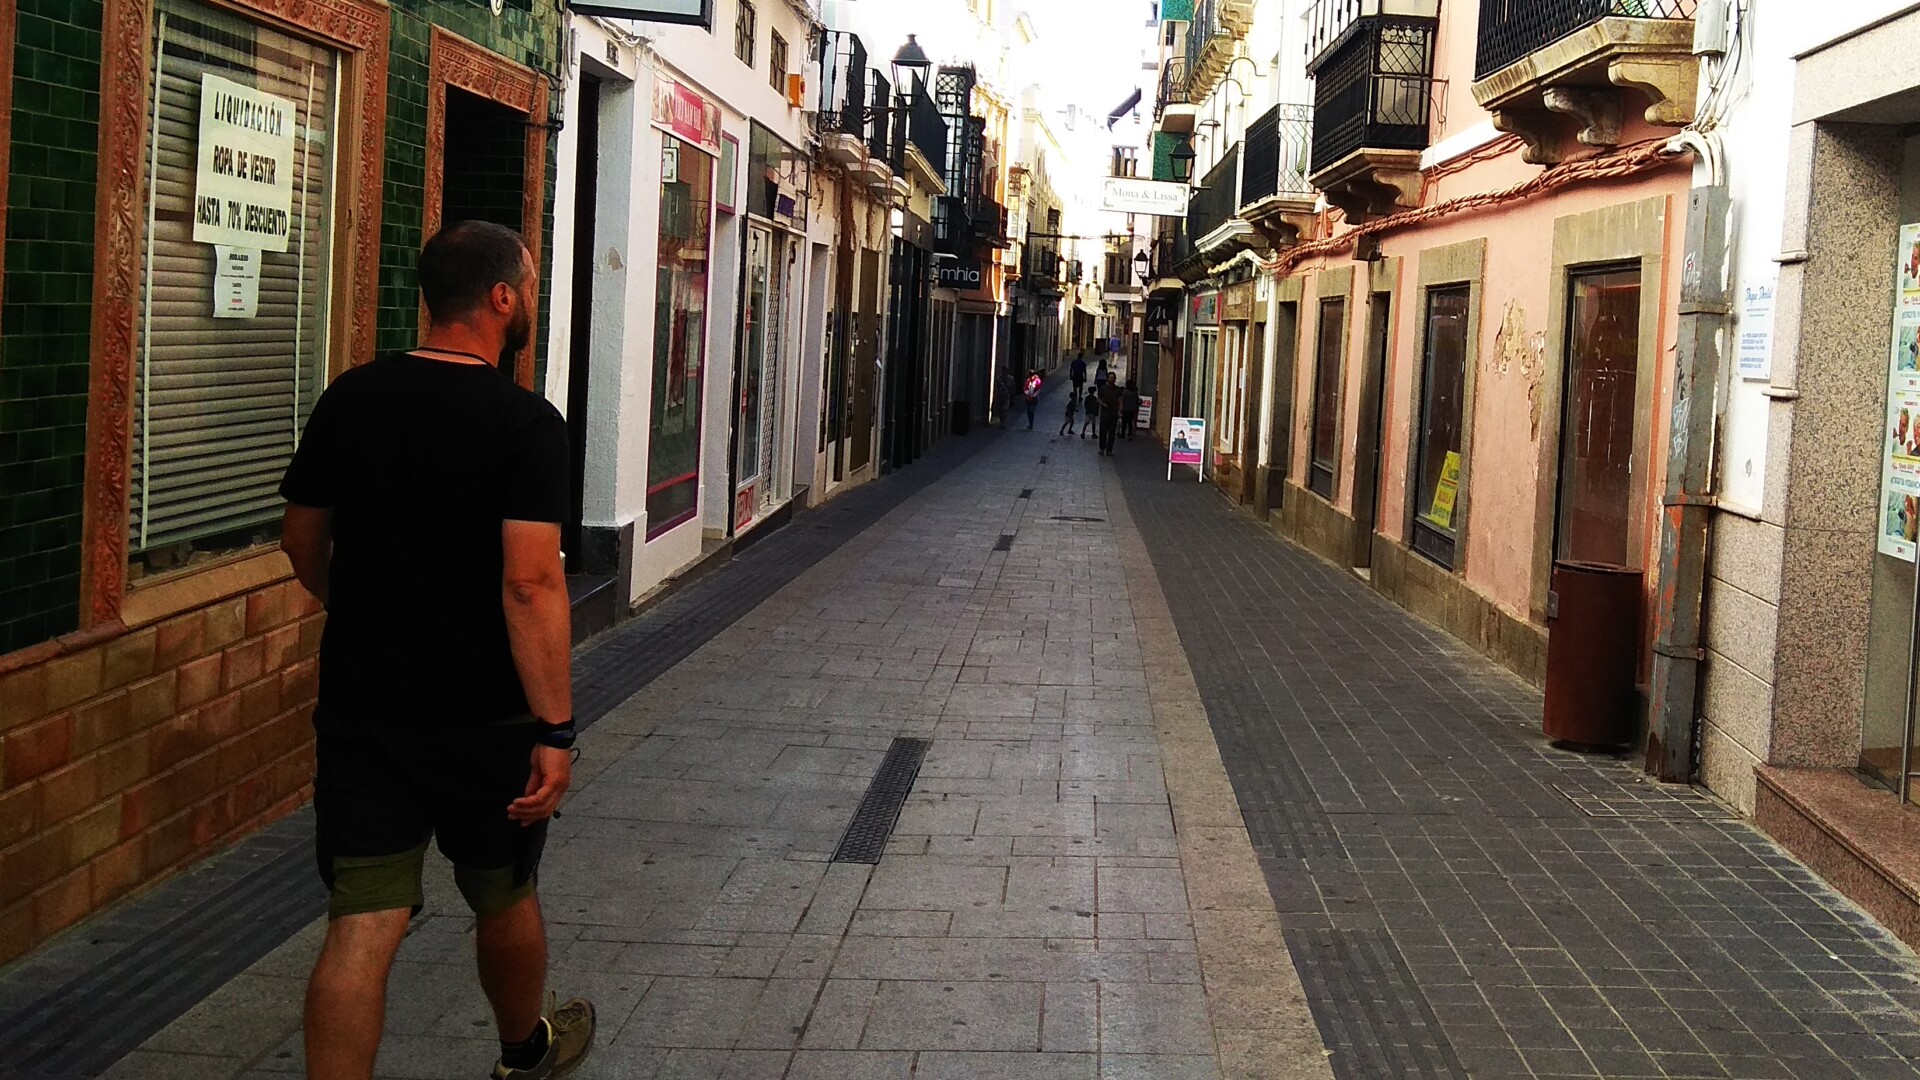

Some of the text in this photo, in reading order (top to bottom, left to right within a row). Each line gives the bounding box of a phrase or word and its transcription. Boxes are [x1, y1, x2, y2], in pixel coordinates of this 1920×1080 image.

[214, 91, 282, 137] LIQUIDACIÓN
[213, 145, 276, 185] ROPA DE VESTIR
[1113, 187, 1139, 199] Mona
[1141, 190, 1150, 200] &
[1153, 190, 1178, 202] Lissa
[196, 195, 288, 237] HASTA 70% DESCUENTO
[940, 266, 980, 282] mhia
